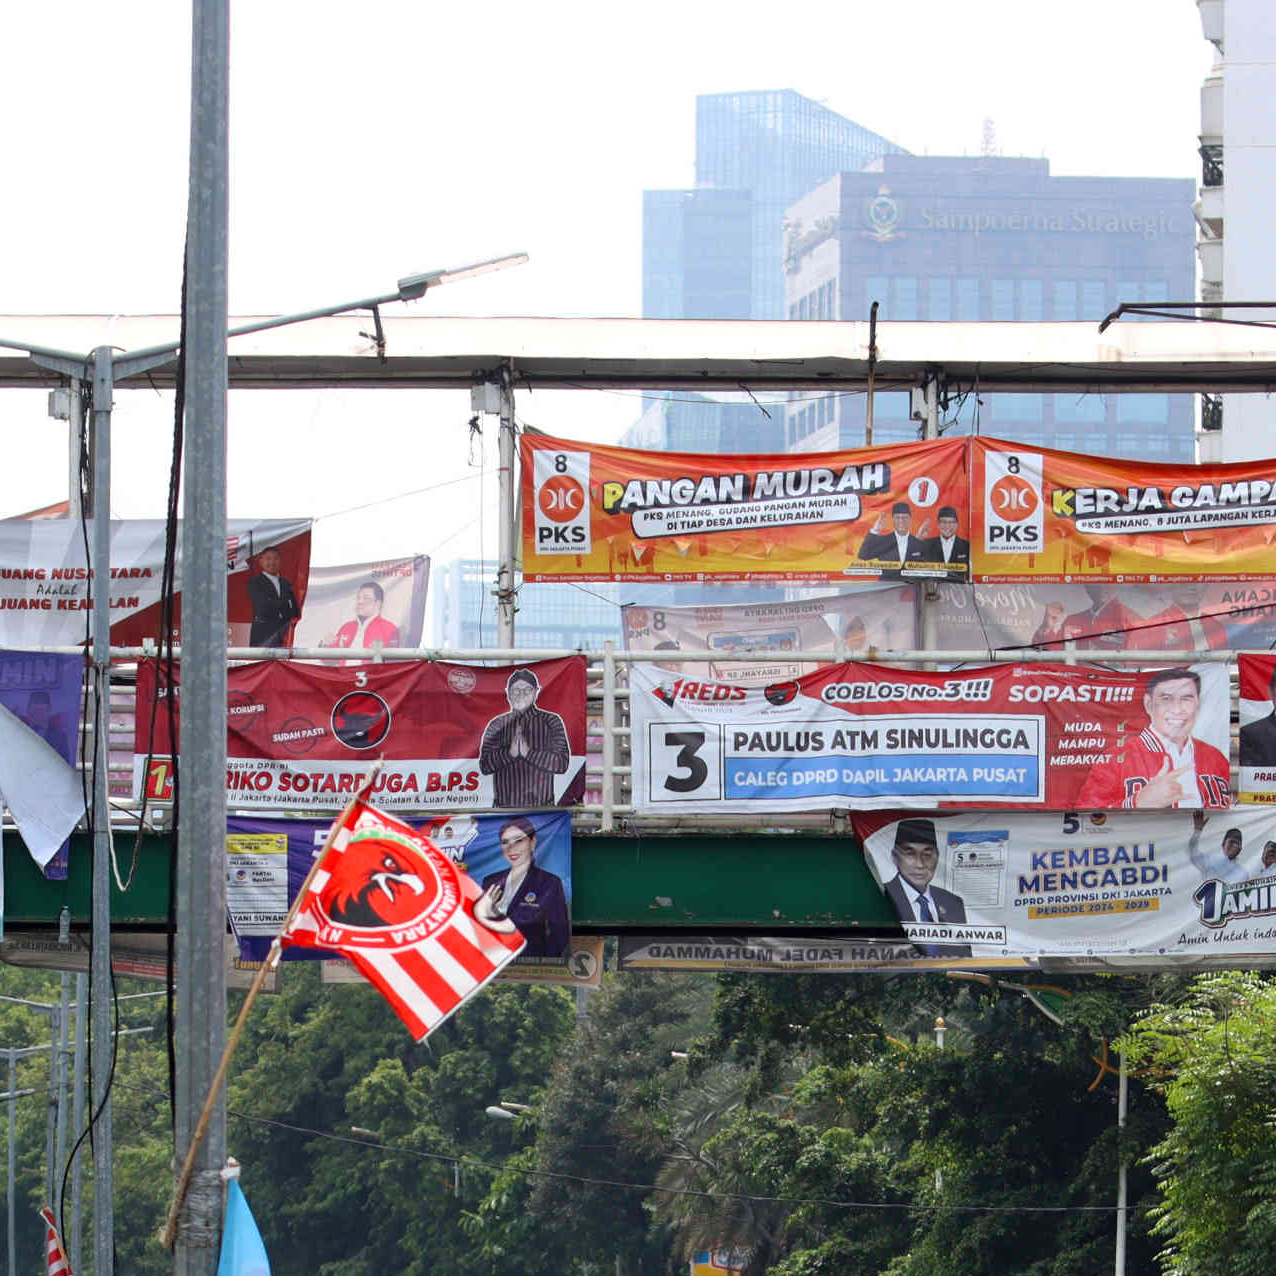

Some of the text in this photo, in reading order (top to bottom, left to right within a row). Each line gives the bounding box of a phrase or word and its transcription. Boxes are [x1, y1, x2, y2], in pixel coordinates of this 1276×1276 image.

[555, 455, 567, 473] 8
[1007, 456, 1021, 474] 8
[604, 463, 887, 512] PANGAN MURAH
[1052, 487, 1165, 516] KERJA
[681, 511, 824, 531] TIAP KELURAHAN
[538, 526, 586, 544] PKS
[989, 526, 1038, 542] PKS
[824, 682, 906, 701] COBLOS
[1009, 685, 1134, 703] SOPASTI!!!
[1064, 722, 1102, 732] MUDA
[734, 728, 1029, 752] PAULUS ATM SINULINGGA
[1058, 737, 1106, 748] MAMPU
[663, 731, 708, 793] 3
[1050, 754, 1111, 766] MERAKYAT
[734, 767, 1027, 787] CALEG DPRD DAPIL JAKARTA PUSAT
[1031, 843, 1155, 871] KEMBALI
[1019, 864, 1169, 894] MENGABDI
[955, 929, 1003, 940] ANWAR
